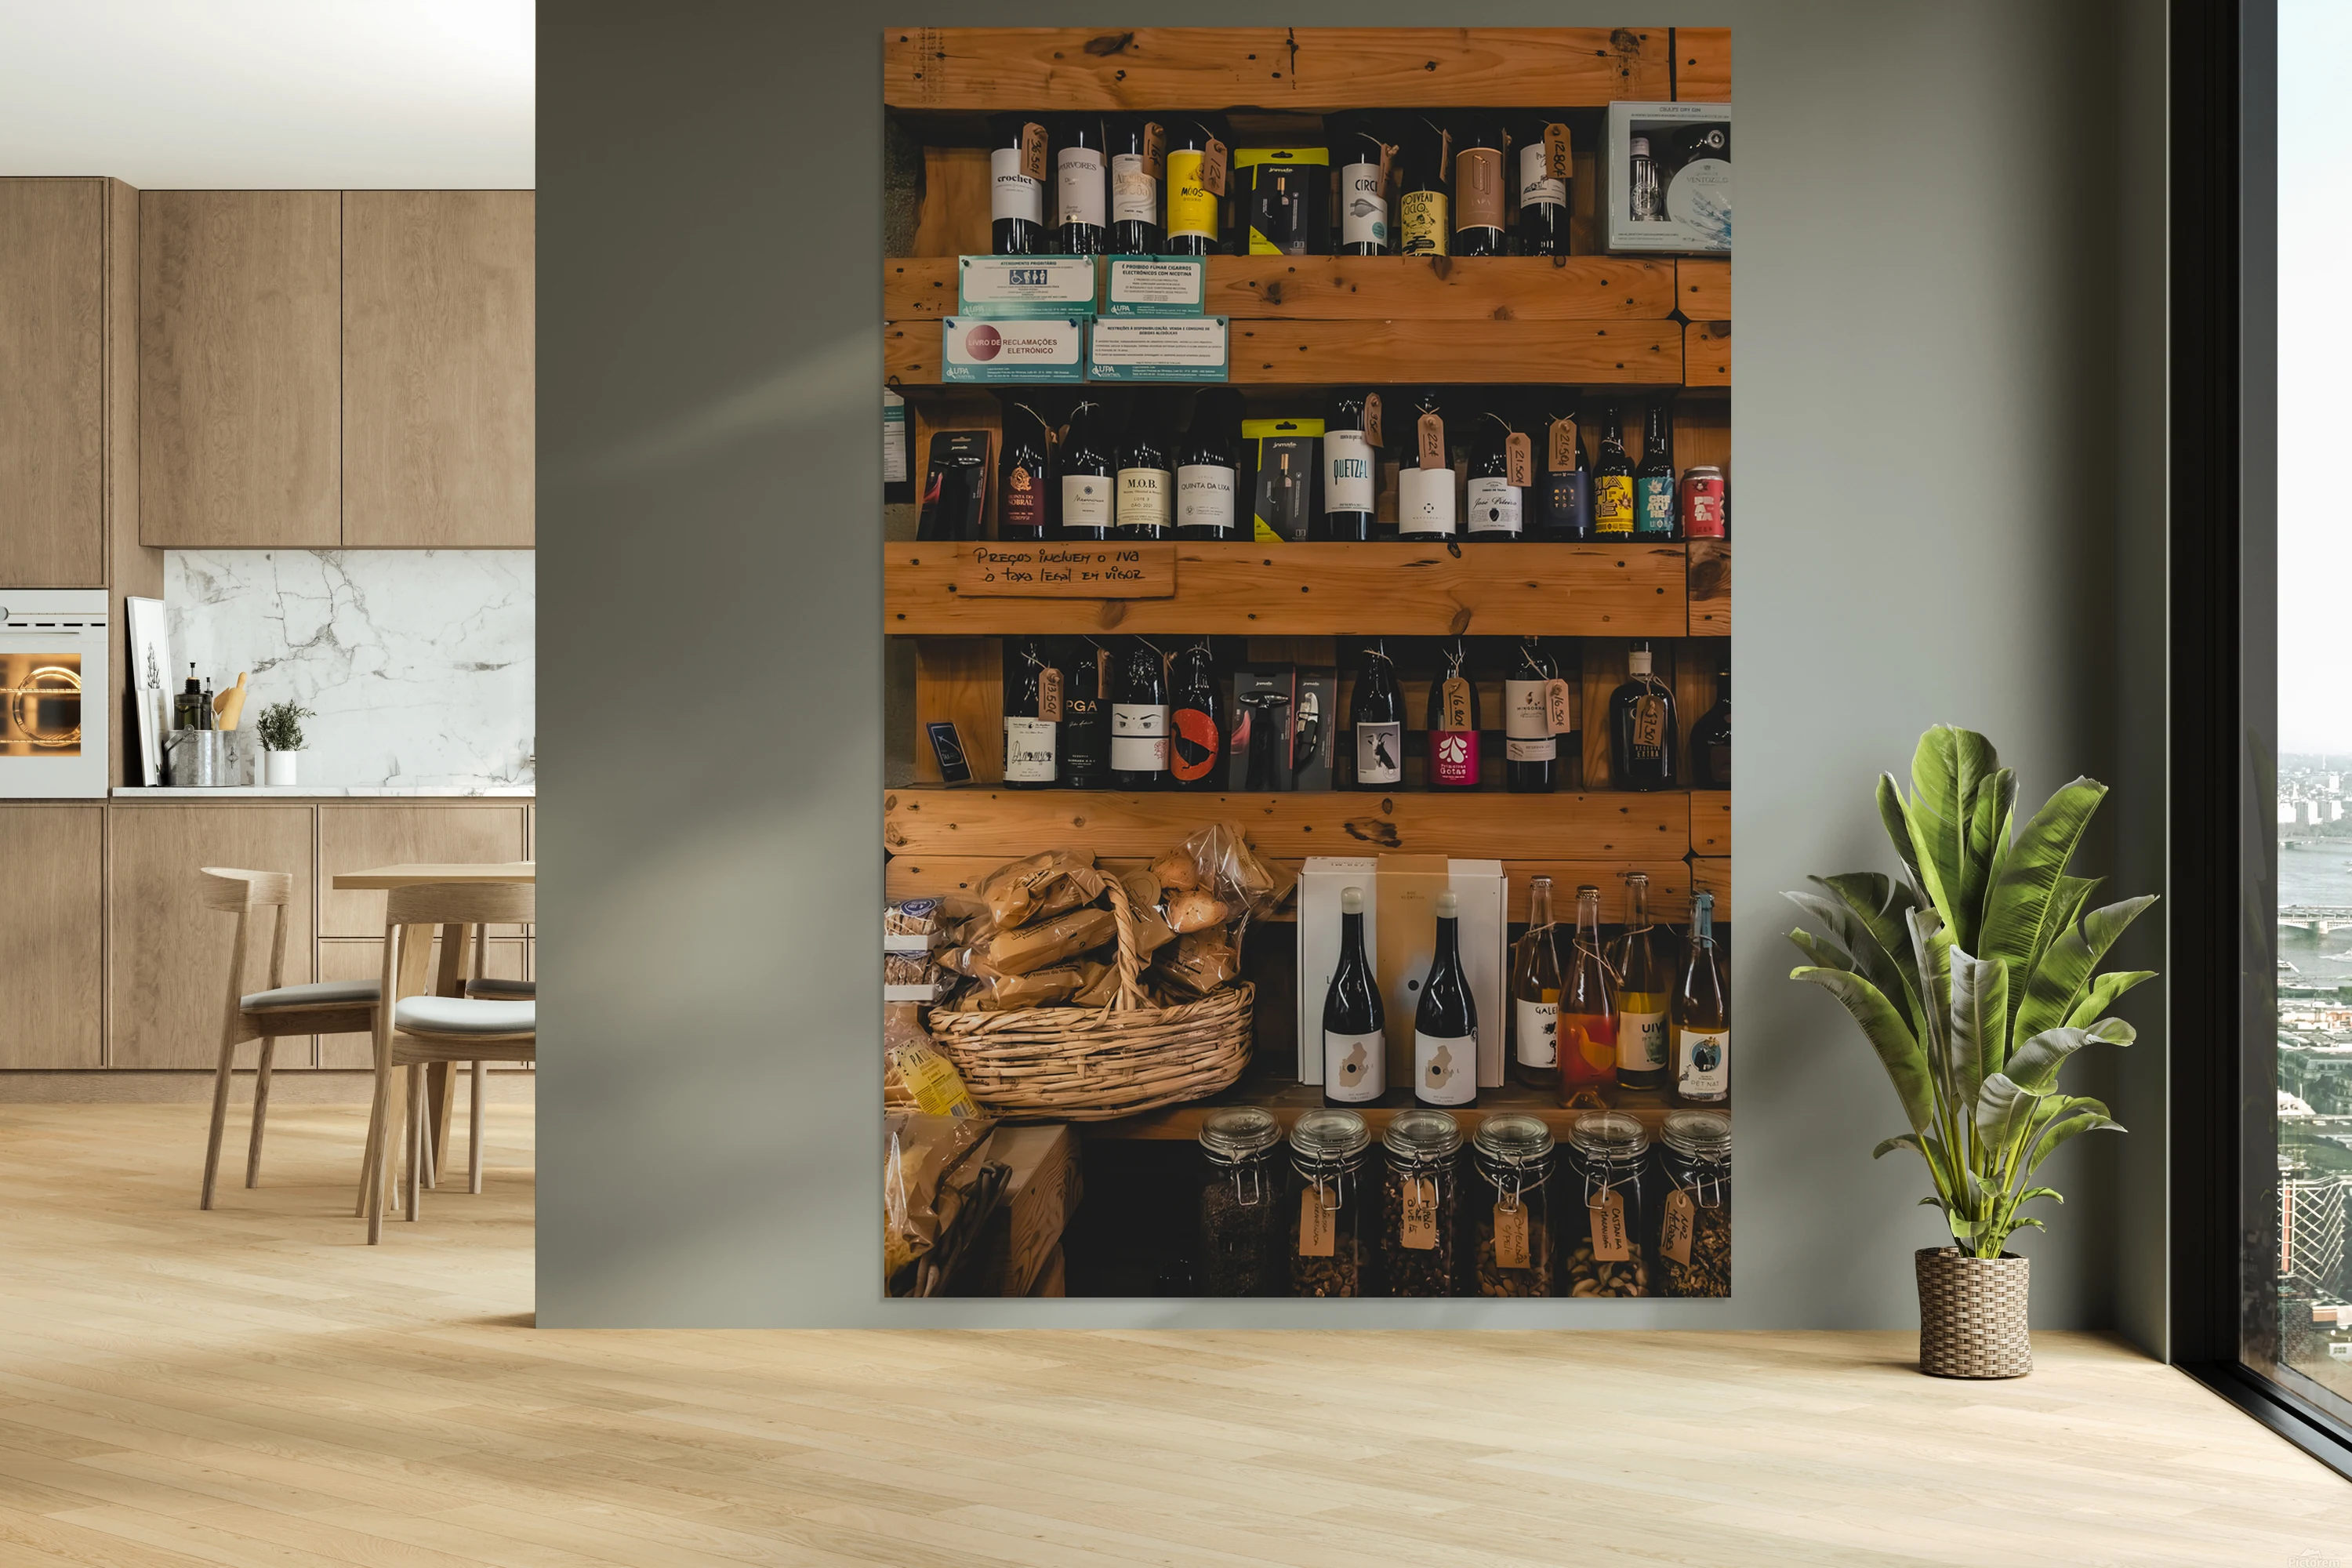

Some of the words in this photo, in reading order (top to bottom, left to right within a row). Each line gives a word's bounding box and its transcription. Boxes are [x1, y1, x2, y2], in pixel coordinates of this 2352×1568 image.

[1552, 140, 1566, 177] 12.80€
[997, 174, 1033, 185] crochet
[1403, 193, 1433, 205] NOUVEAU
[1334, 459, 1368, 485] QUETZAL
[1127, 478, 1157, 488] M.O.B.
[1181, 482, 1206, 491] QUINTA
